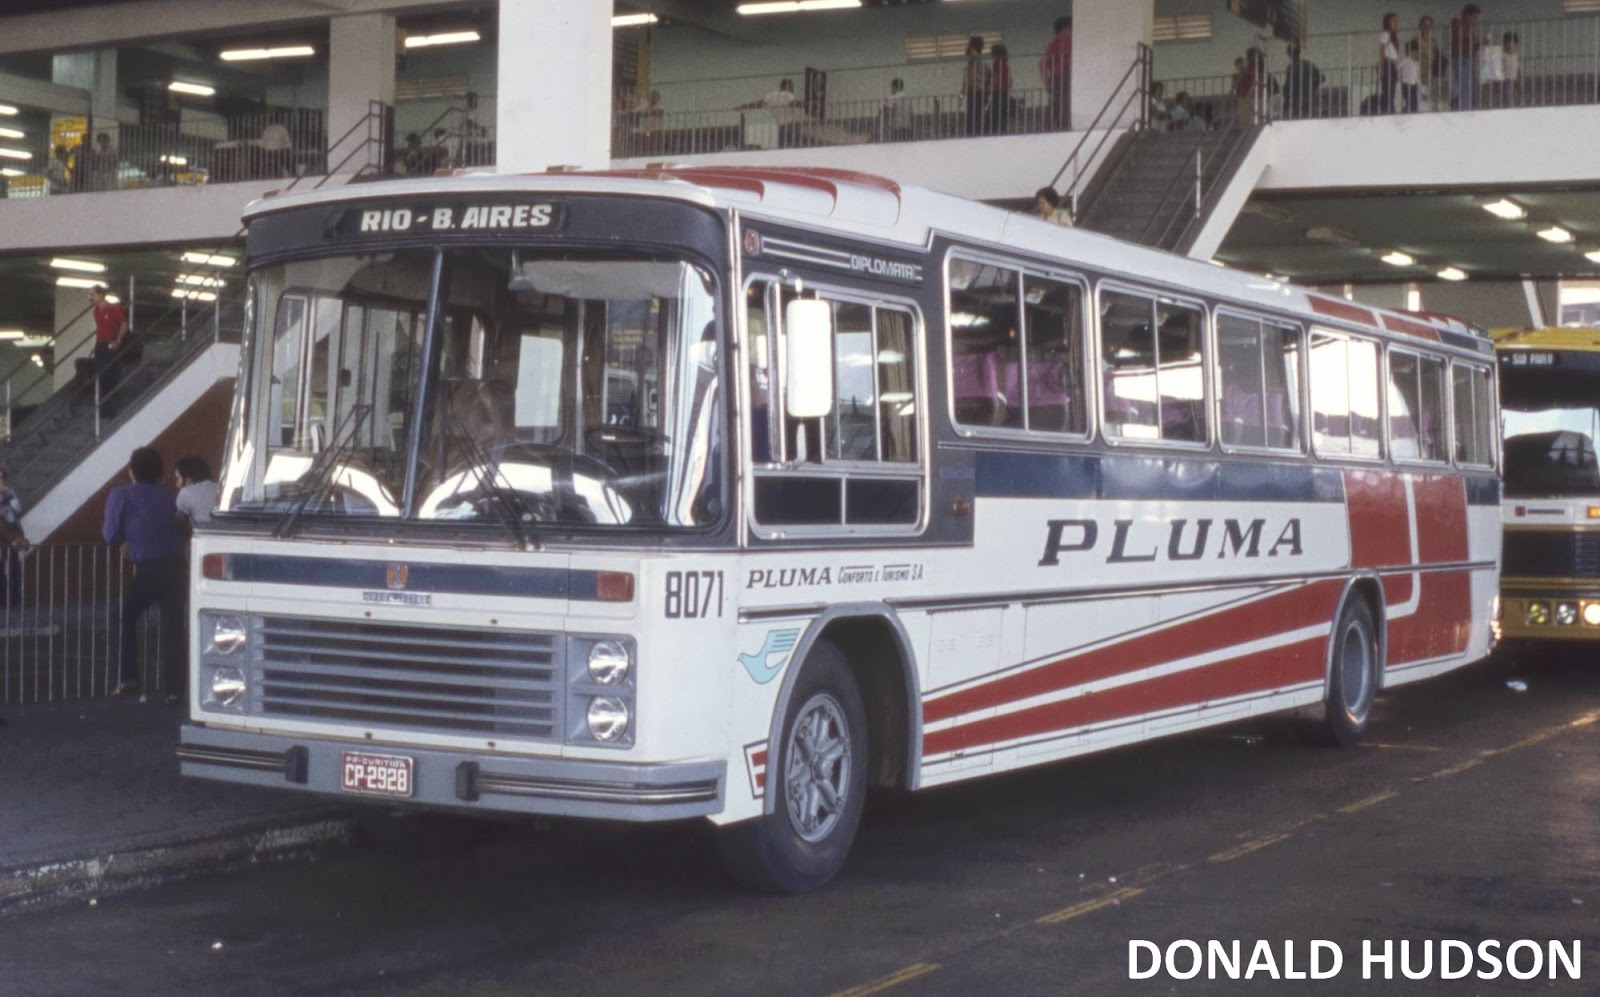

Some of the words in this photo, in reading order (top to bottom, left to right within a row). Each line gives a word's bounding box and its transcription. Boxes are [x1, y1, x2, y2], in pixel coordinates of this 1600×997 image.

[361, 209, 412, 231] RIO
[460, 204, 552, 229] AIRES
[850, 254, 914, 280] DIPLOMATA
[1037, 518, 1304, 567] PLUMA
[745, 566, 833, 590] PLUMA
[664, 570, 724, 619] 8071
